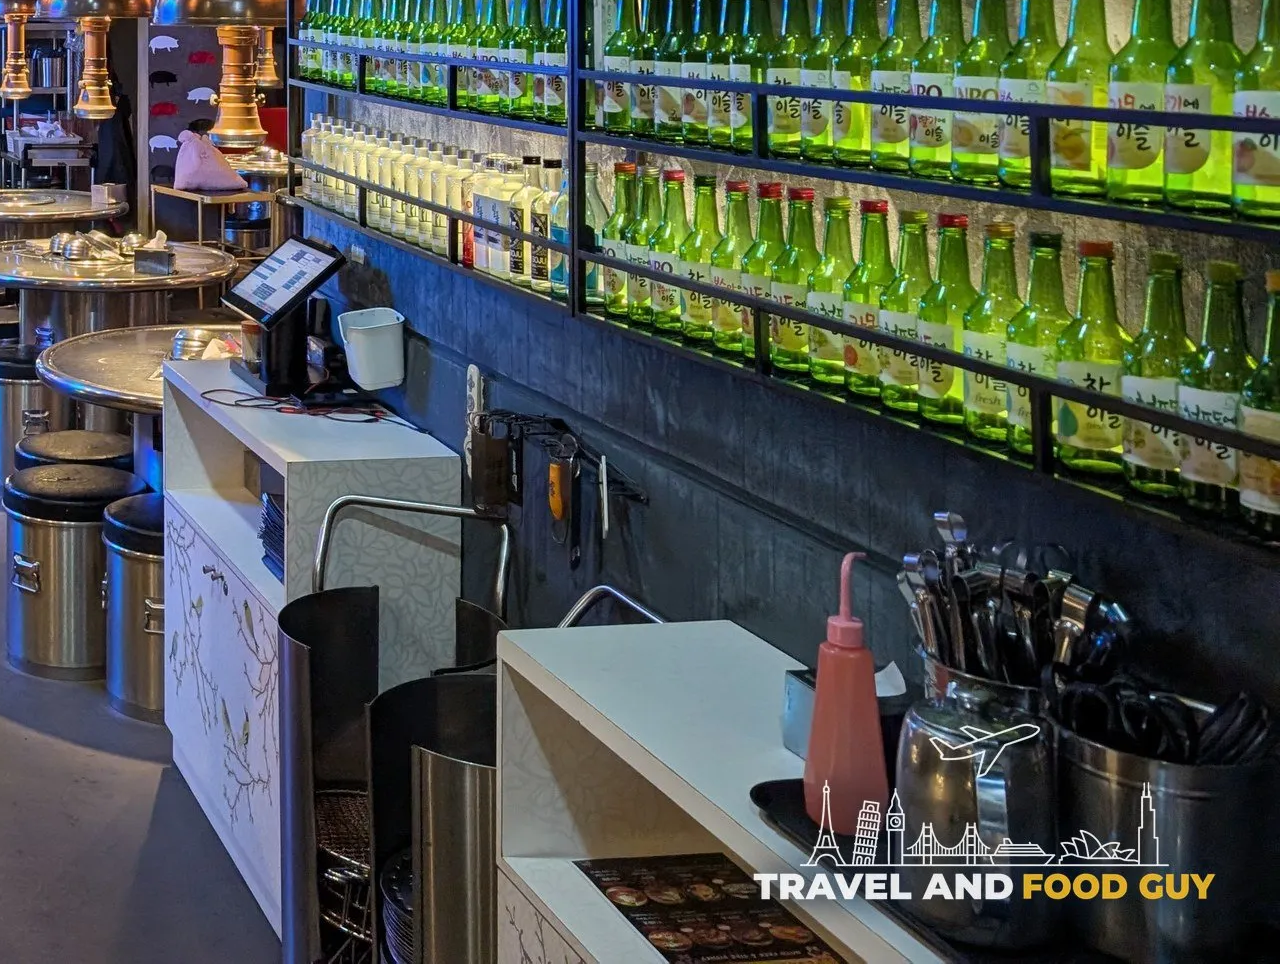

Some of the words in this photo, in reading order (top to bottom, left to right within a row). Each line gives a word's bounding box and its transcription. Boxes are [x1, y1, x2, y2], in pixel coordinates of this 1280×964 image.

[776, 97, 801, 119] 이슬
[924, 127, 943, 142] 이슬
[974, 393, 1001, 407] fresh
